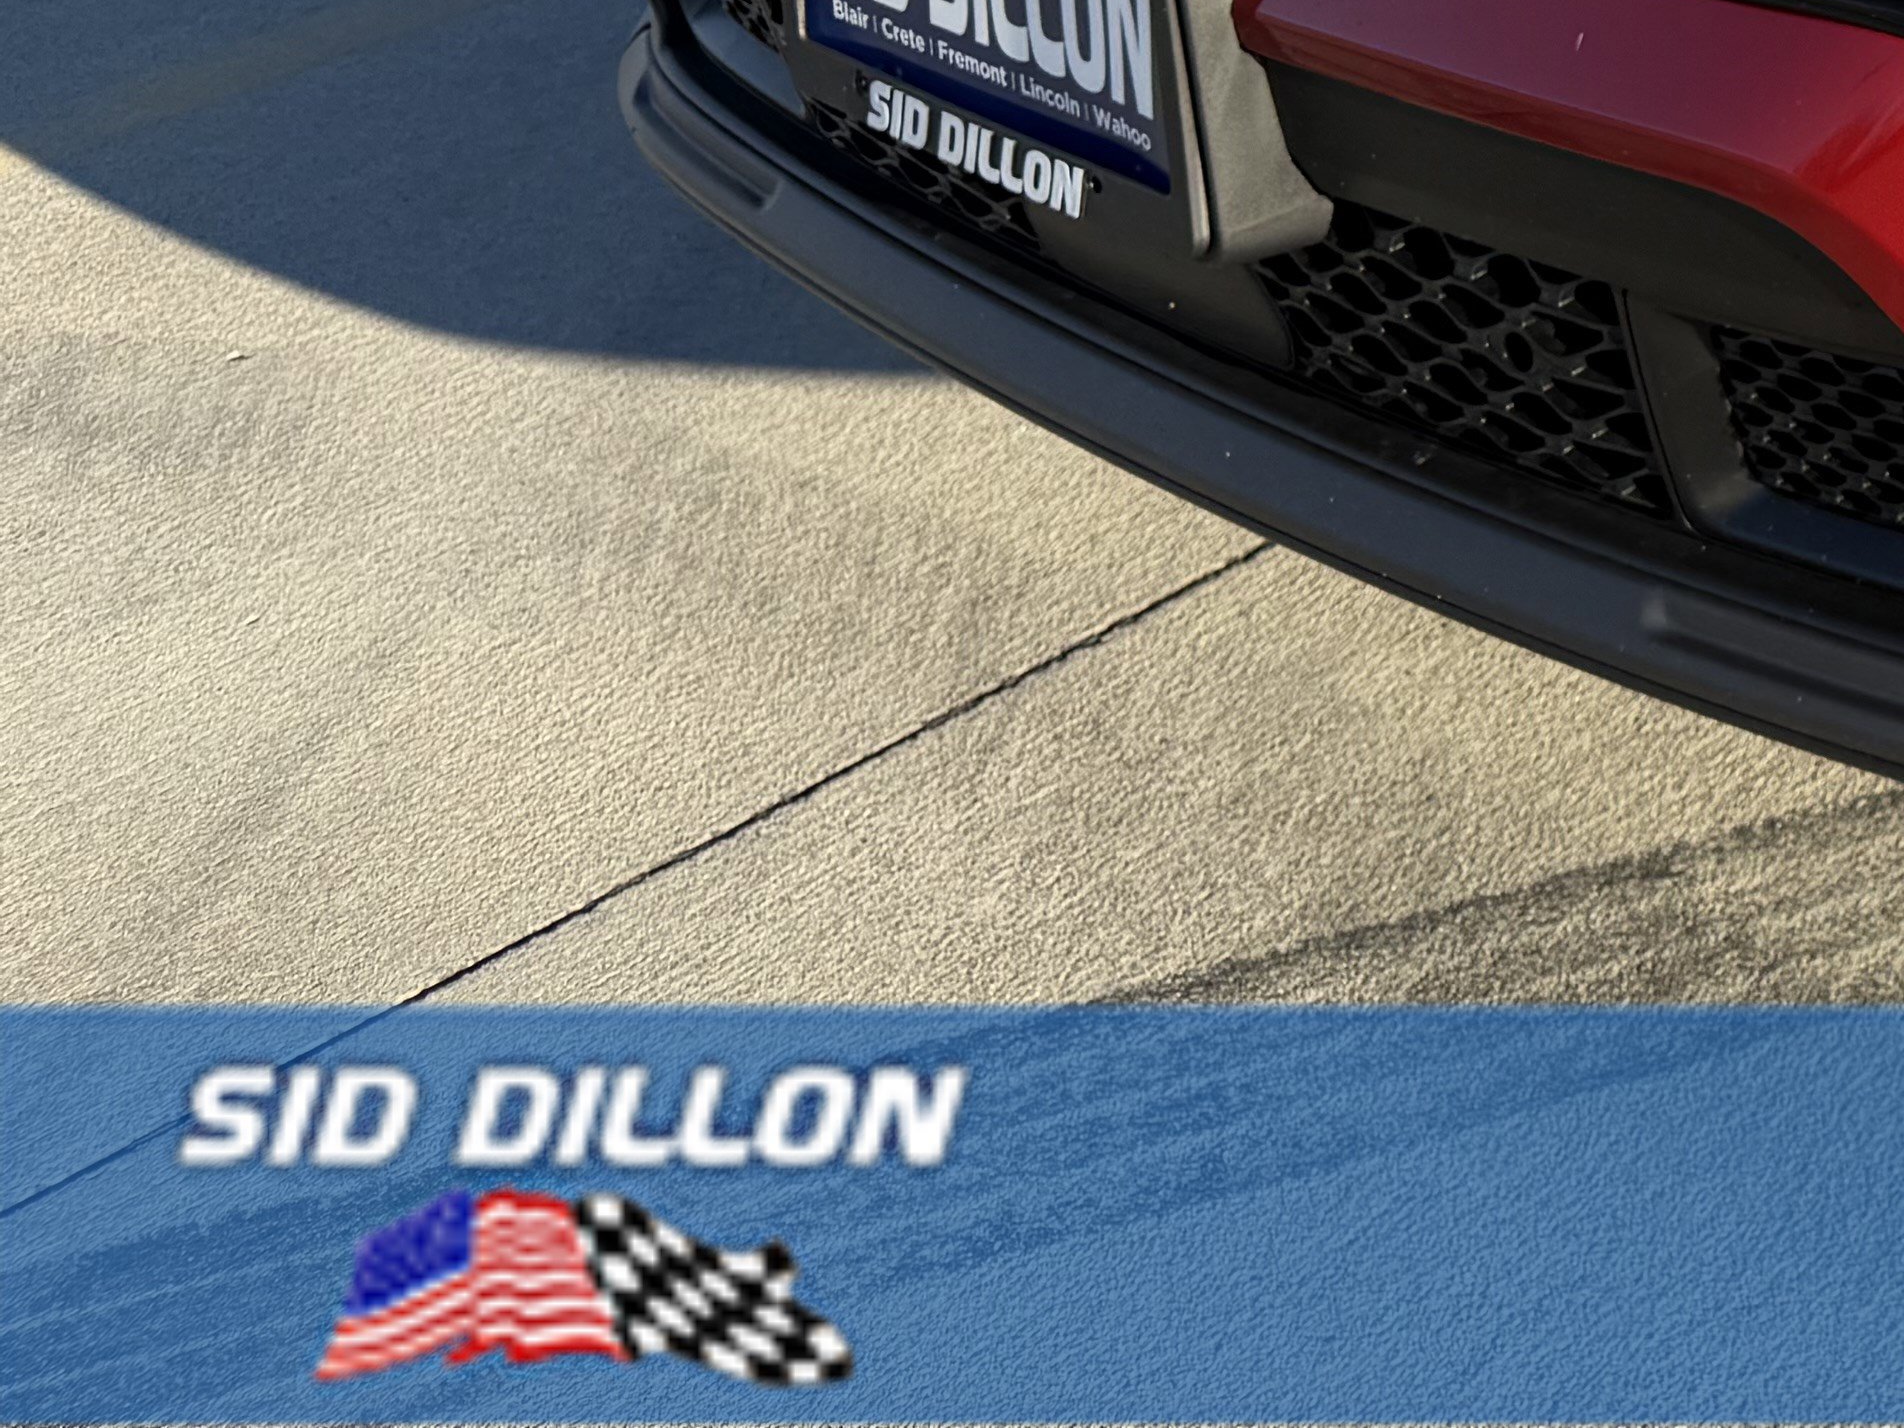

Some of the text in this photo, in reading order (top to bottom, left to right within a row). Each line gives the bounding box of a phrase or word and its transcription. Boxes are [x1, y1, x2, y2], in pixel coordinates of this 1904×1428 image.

[866, 80, 1085, 220] SID DILLON
[881, 18, 926, 53] Crete
[937, 39, 1008, 86] Fremont
[1019, 74, 1081, 119] Lincoln
[1093, 104, 1152, 152] Wahoo
